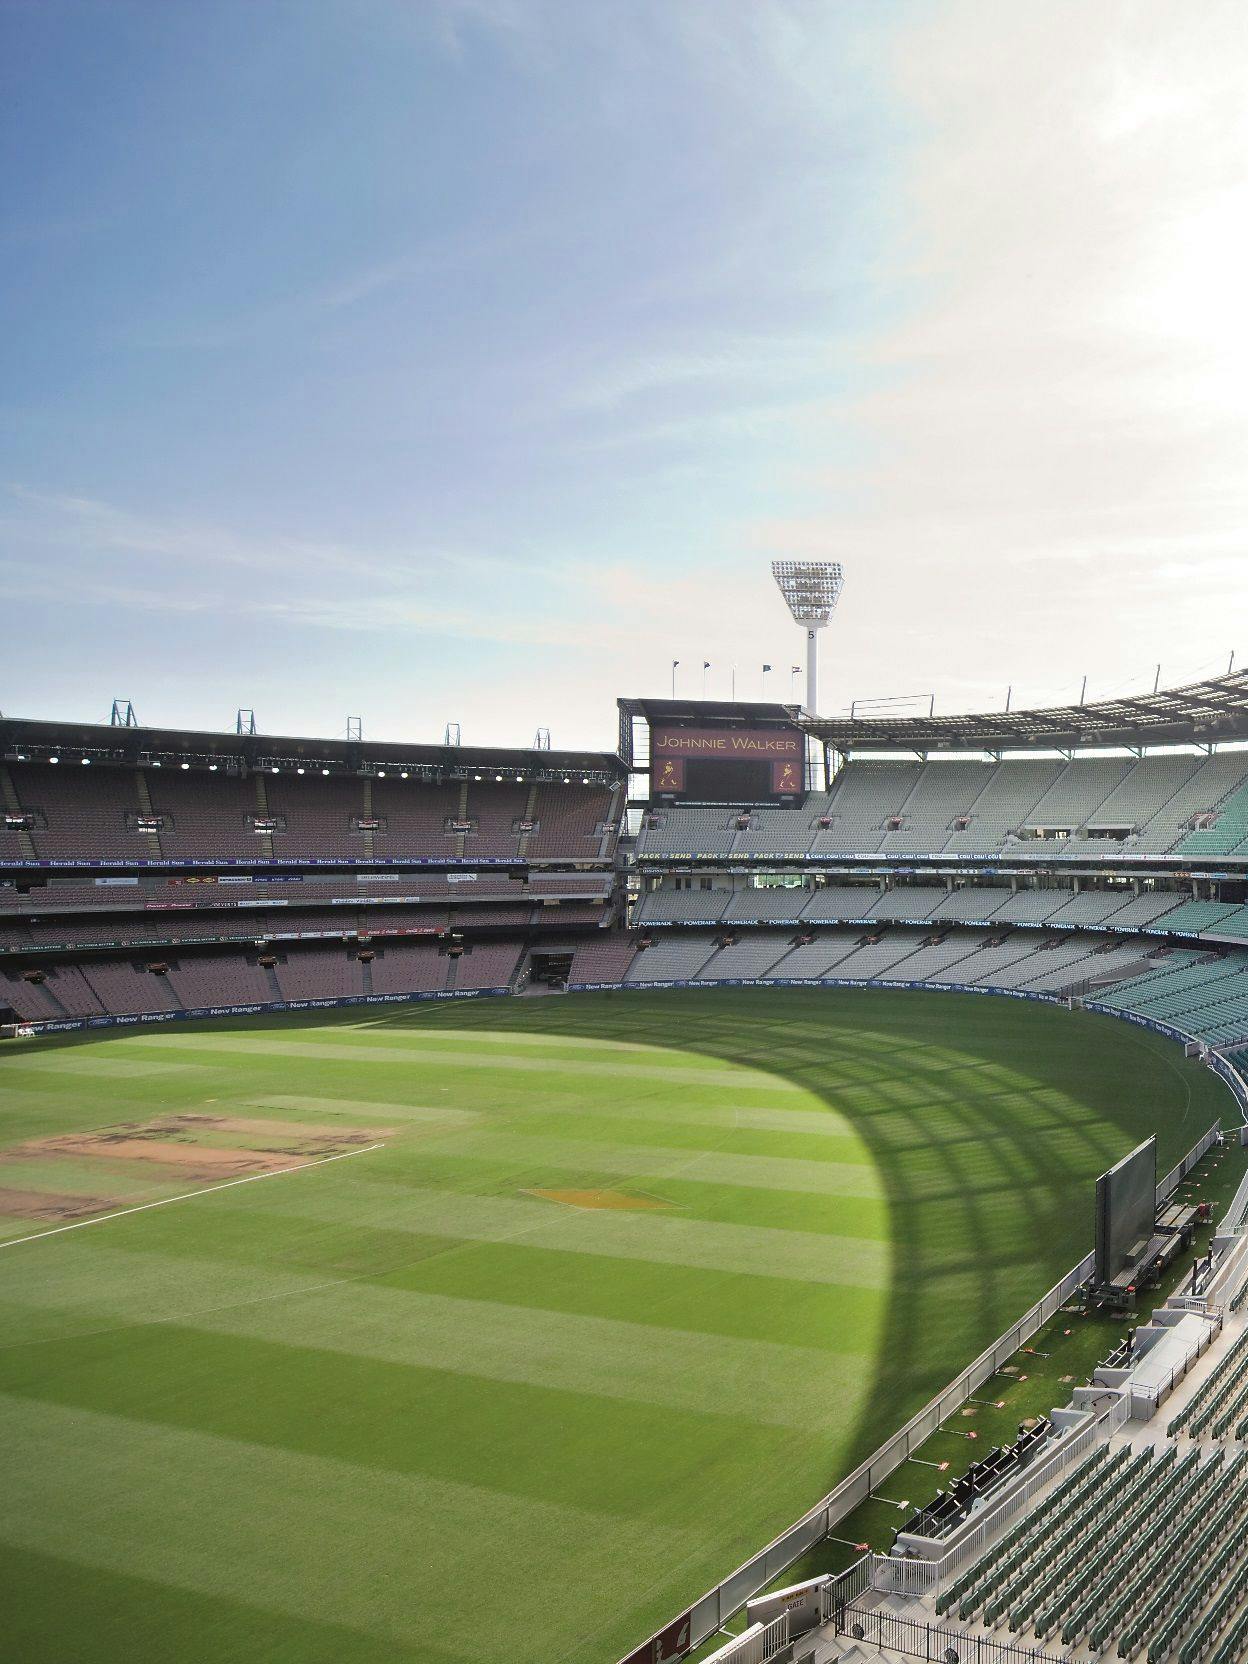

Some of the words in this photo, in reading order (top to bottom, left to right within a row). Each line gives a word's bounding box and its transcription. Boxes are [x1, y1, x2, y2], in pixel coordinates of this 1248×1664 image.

[657, 736, 726, 749] JOHNNIE
[732, 737, 796, 750] WALKER
[232, 1006, 261, 1014] Ranger
[141, 1012, 175, 1022] Ranger
[47, 1022, 82, 1030] Ranger
